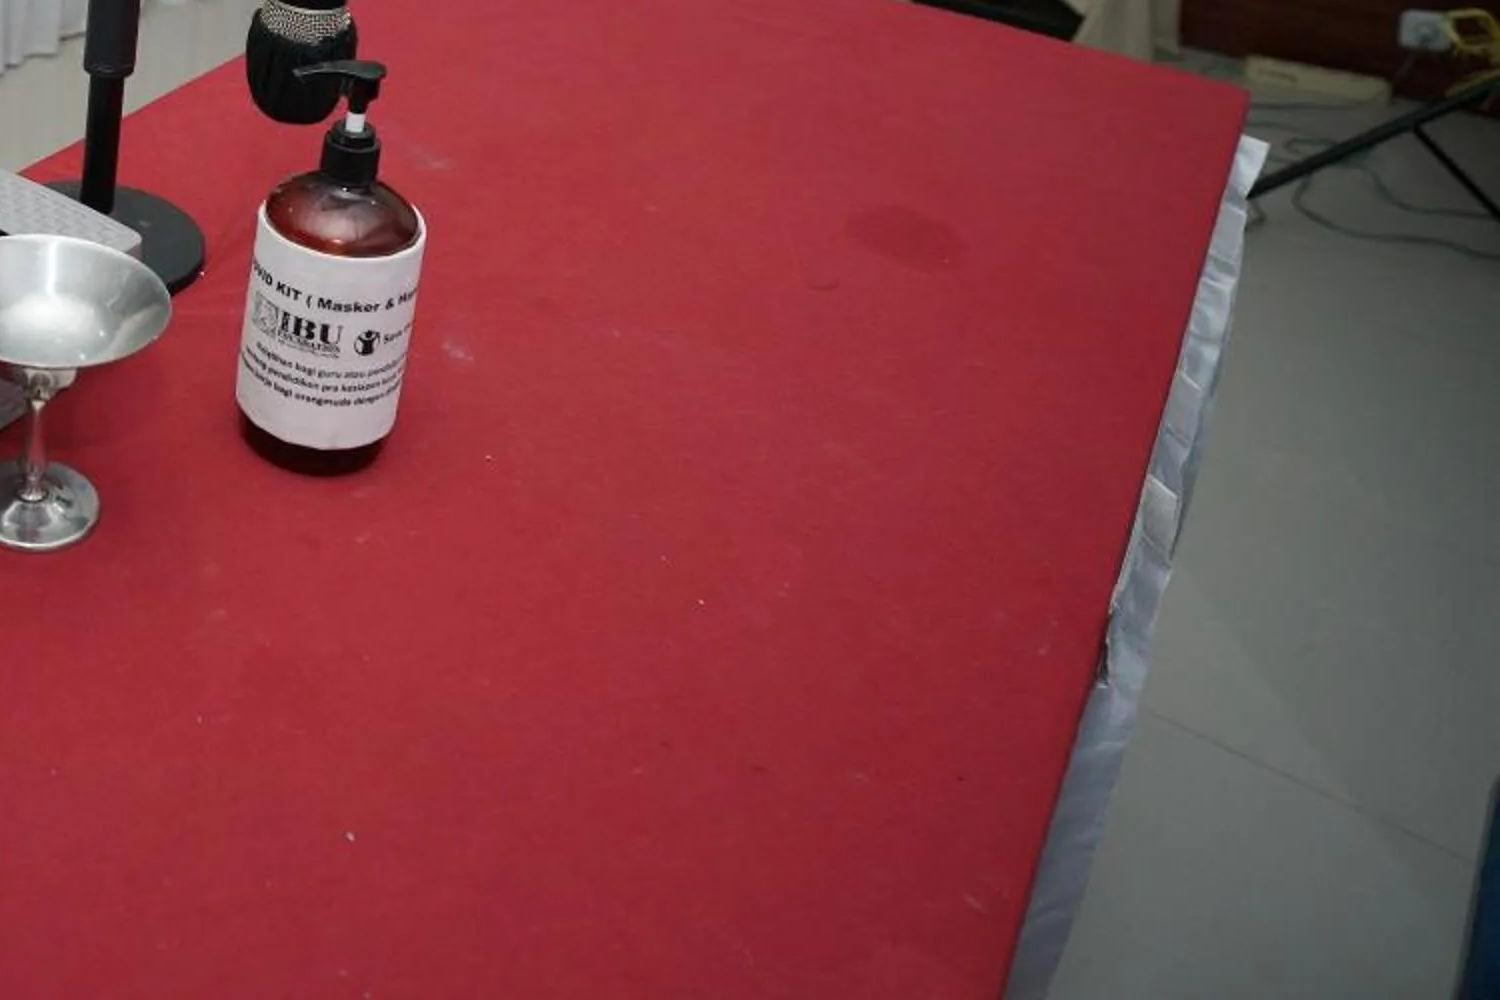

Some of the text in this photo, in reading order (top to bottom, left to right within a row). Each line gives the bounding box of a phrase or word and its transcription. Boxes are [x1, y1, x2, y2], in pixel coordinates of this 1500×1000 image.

[276, 281, 303, 301] KIT
[306, 295, 313, 309] (
[317, 297, 380, 313] Masker
[385, 298, 395, 311] &
[281, 311, 344, 345] IBU
[295, 361, 317, 377] bagi
[273, 381, 294, 398] bagi
[321, 384, 339, 393] pra
